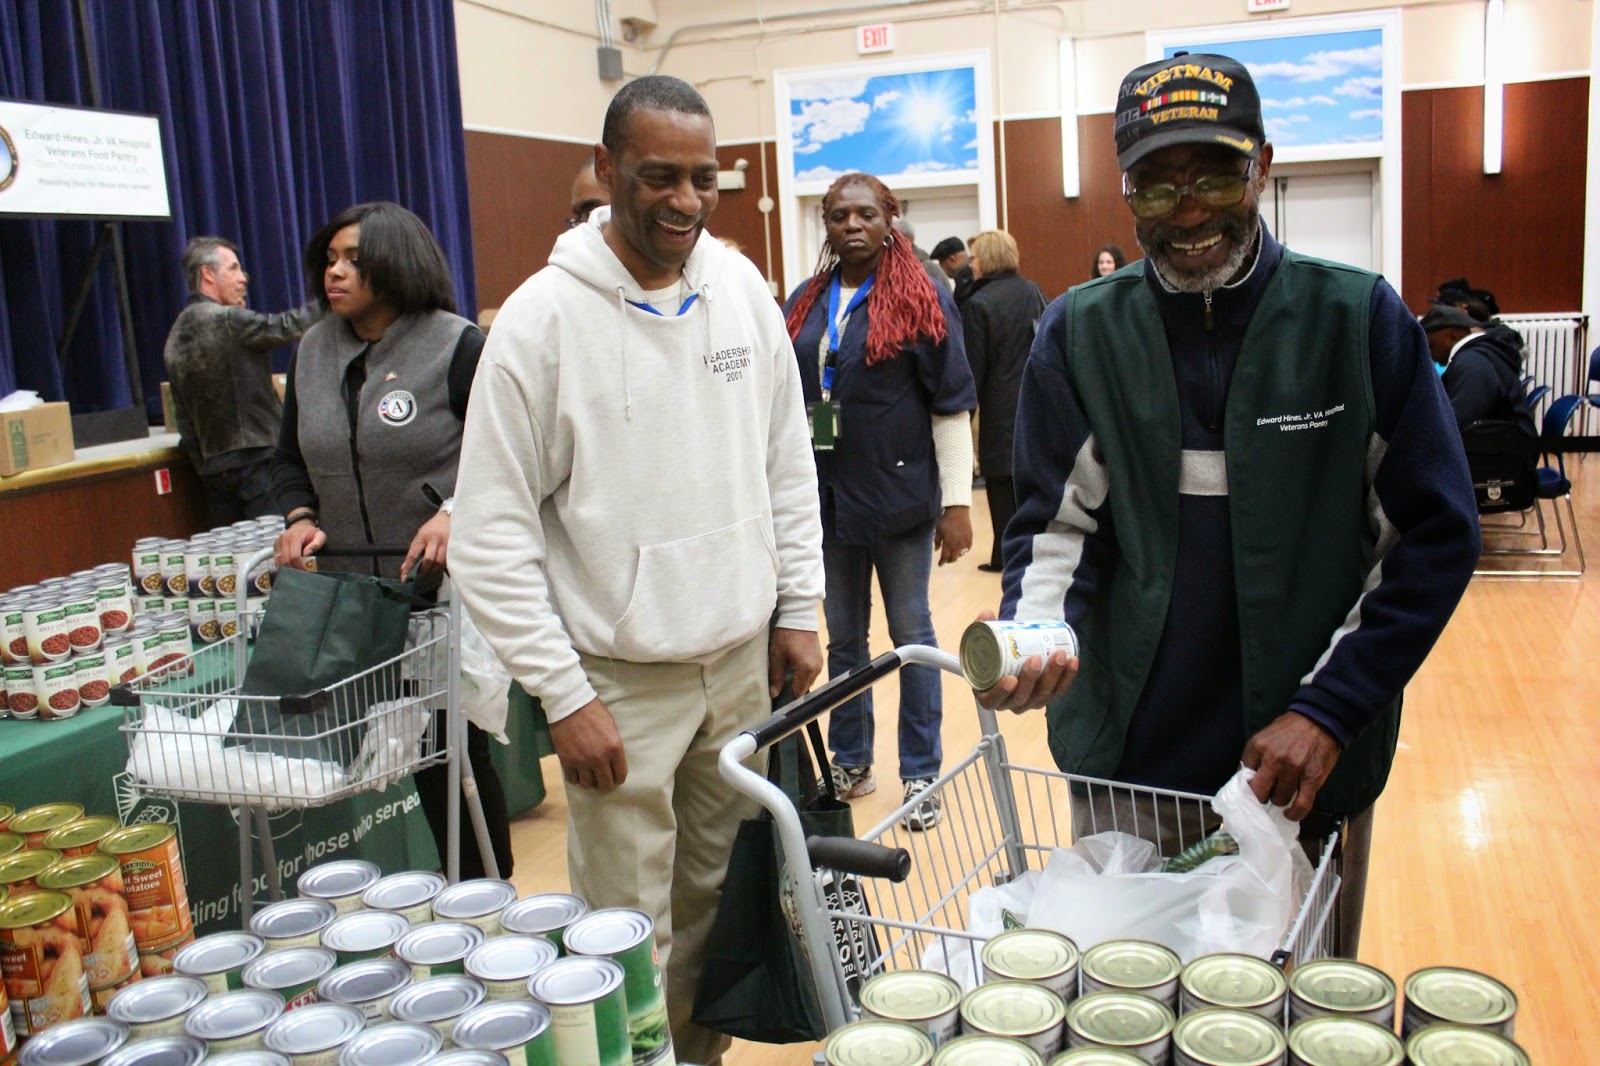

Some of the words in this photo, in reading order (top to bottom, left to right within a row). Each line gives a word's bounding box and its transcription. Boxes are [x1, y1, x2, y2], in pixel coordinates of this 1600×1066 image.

[863, 27, 887, 48] EXIT
[1135, 64, 1233, 96] VIETNAM
[1151, 106, 1218, 125] VETERAN
[25, 129, 60, 142] Edward
[46, 146, 86, 159] Veterans
[88, 149, 109, 160] Food
[713, 358, 751, 374] ACADEMY
[726, 371, 742, 382] 2001
[1257, 415, 1282, 426] Edward
[1283, 414, 1303, 422] Hines,
[1304, 412, 1313, 420] Jr.
[1313, 411, 1324, 419] VA
[1325, 403, 1345, 417] Hospital
[1280, 423, 1308, 432] Veterans
[1309, 420, 1329, 429] Pantry
[277, 855, 304, 887] for
[352, 813, 373, 843] who
[133, 869, 163, 884] Sweet
[126, 880, 161, 893] otatoes
[3, 953, 27, 963] weet
